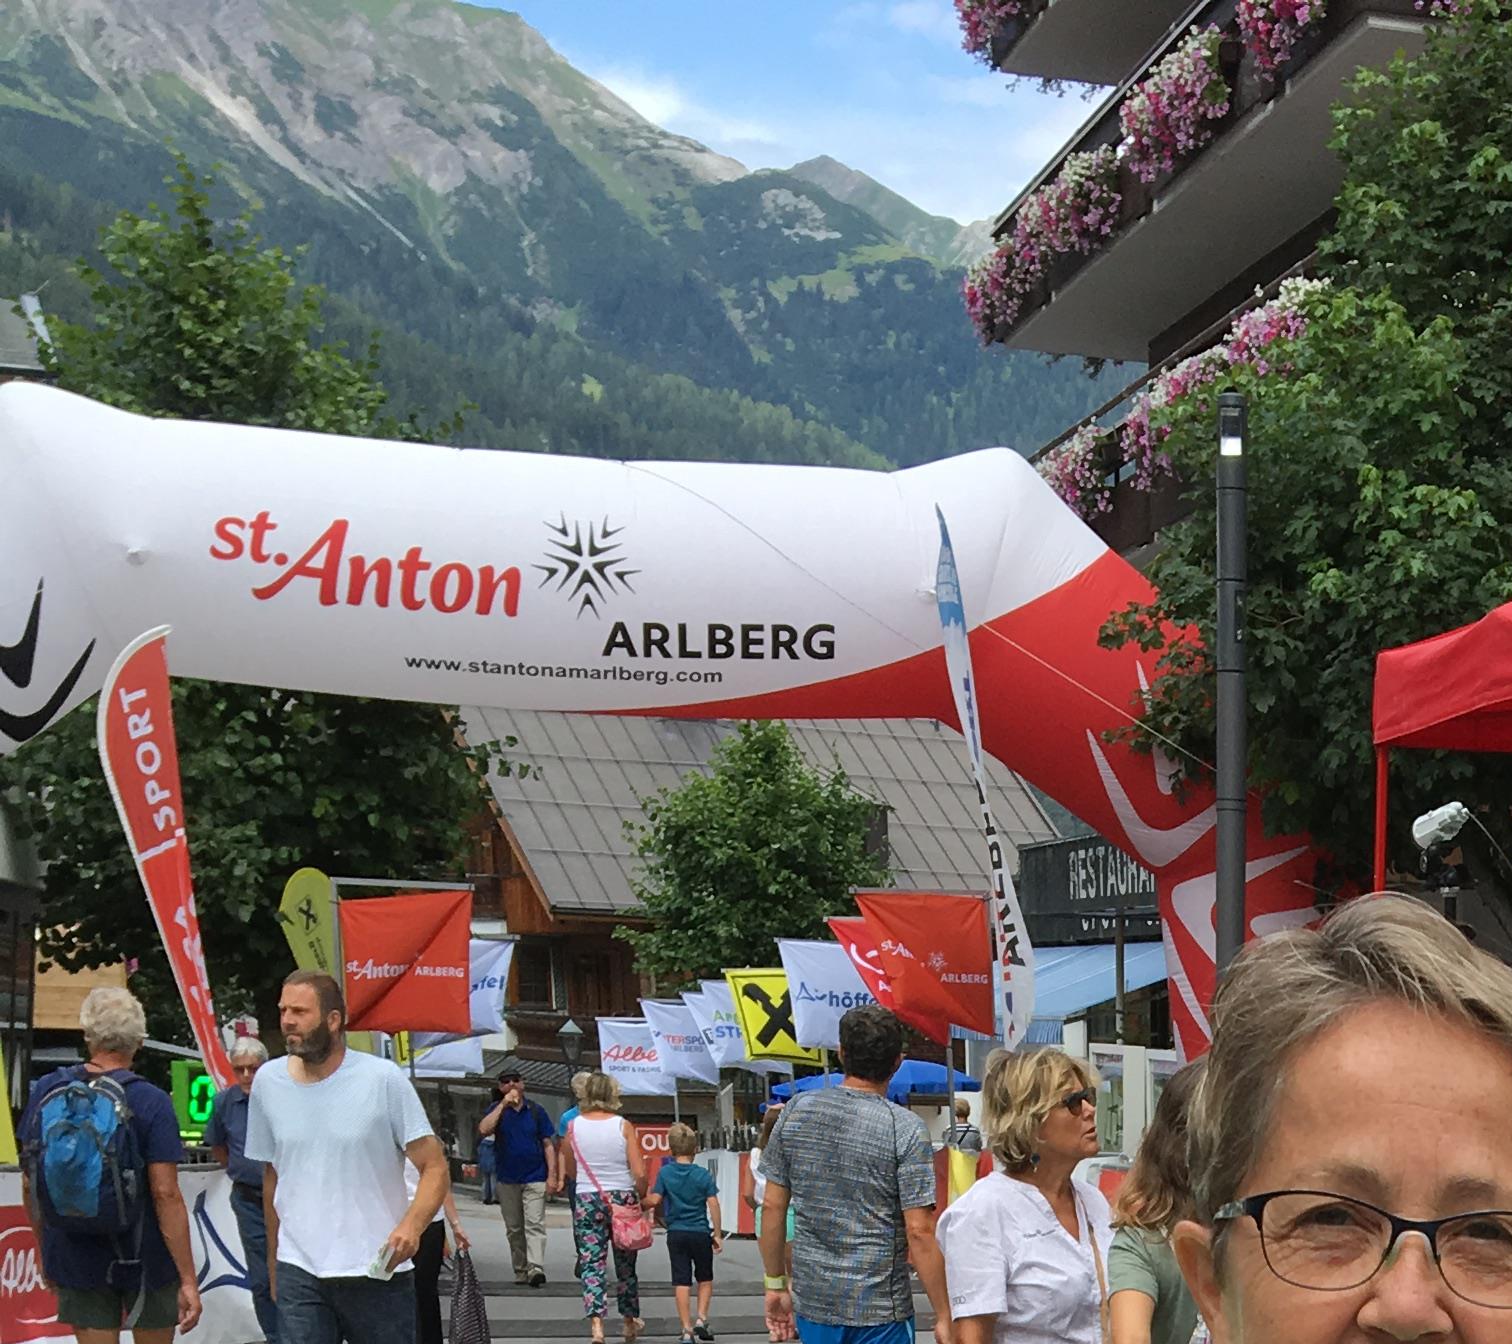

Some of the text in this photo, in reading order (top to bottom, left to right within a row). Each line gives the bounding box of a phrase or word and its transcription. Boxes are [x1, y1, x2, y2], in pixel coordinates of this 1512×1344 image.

[602, 621, 837, 661] ARLBERG
[404, 653, 723, 686] www.stantonamarlberg.com
[118, 686, 178, 834] SPORT
[414, 966, 465, 978] ARLBERG
[940, 973, 989, 985] ARLBERG
[641, 1133, 670, 1152] OU
